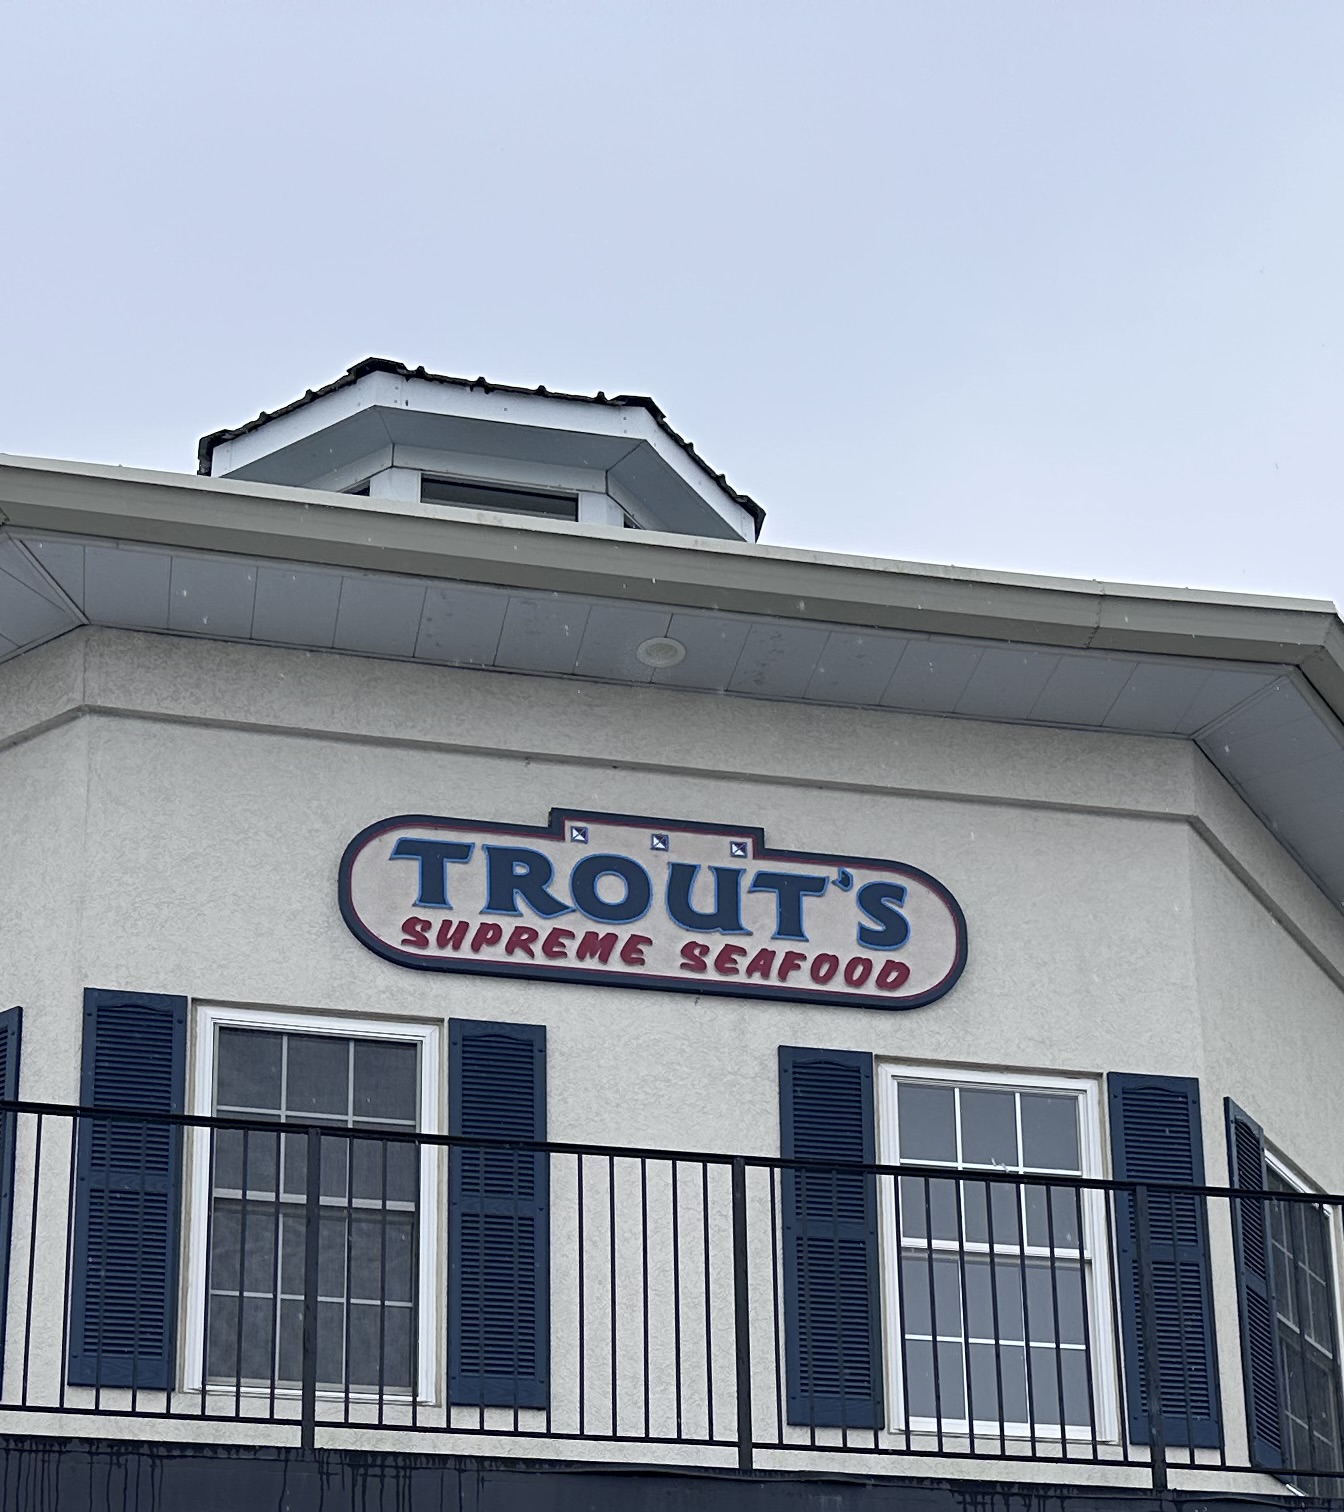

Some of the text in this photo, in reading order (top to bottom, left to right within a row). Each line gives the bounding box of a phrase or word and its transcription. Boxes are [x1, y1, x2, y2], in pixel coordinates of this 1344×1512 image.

[389, 836, 910, 951] TROUT'S
[401, 916, 911, 991] SUPREME SEAFOOD
